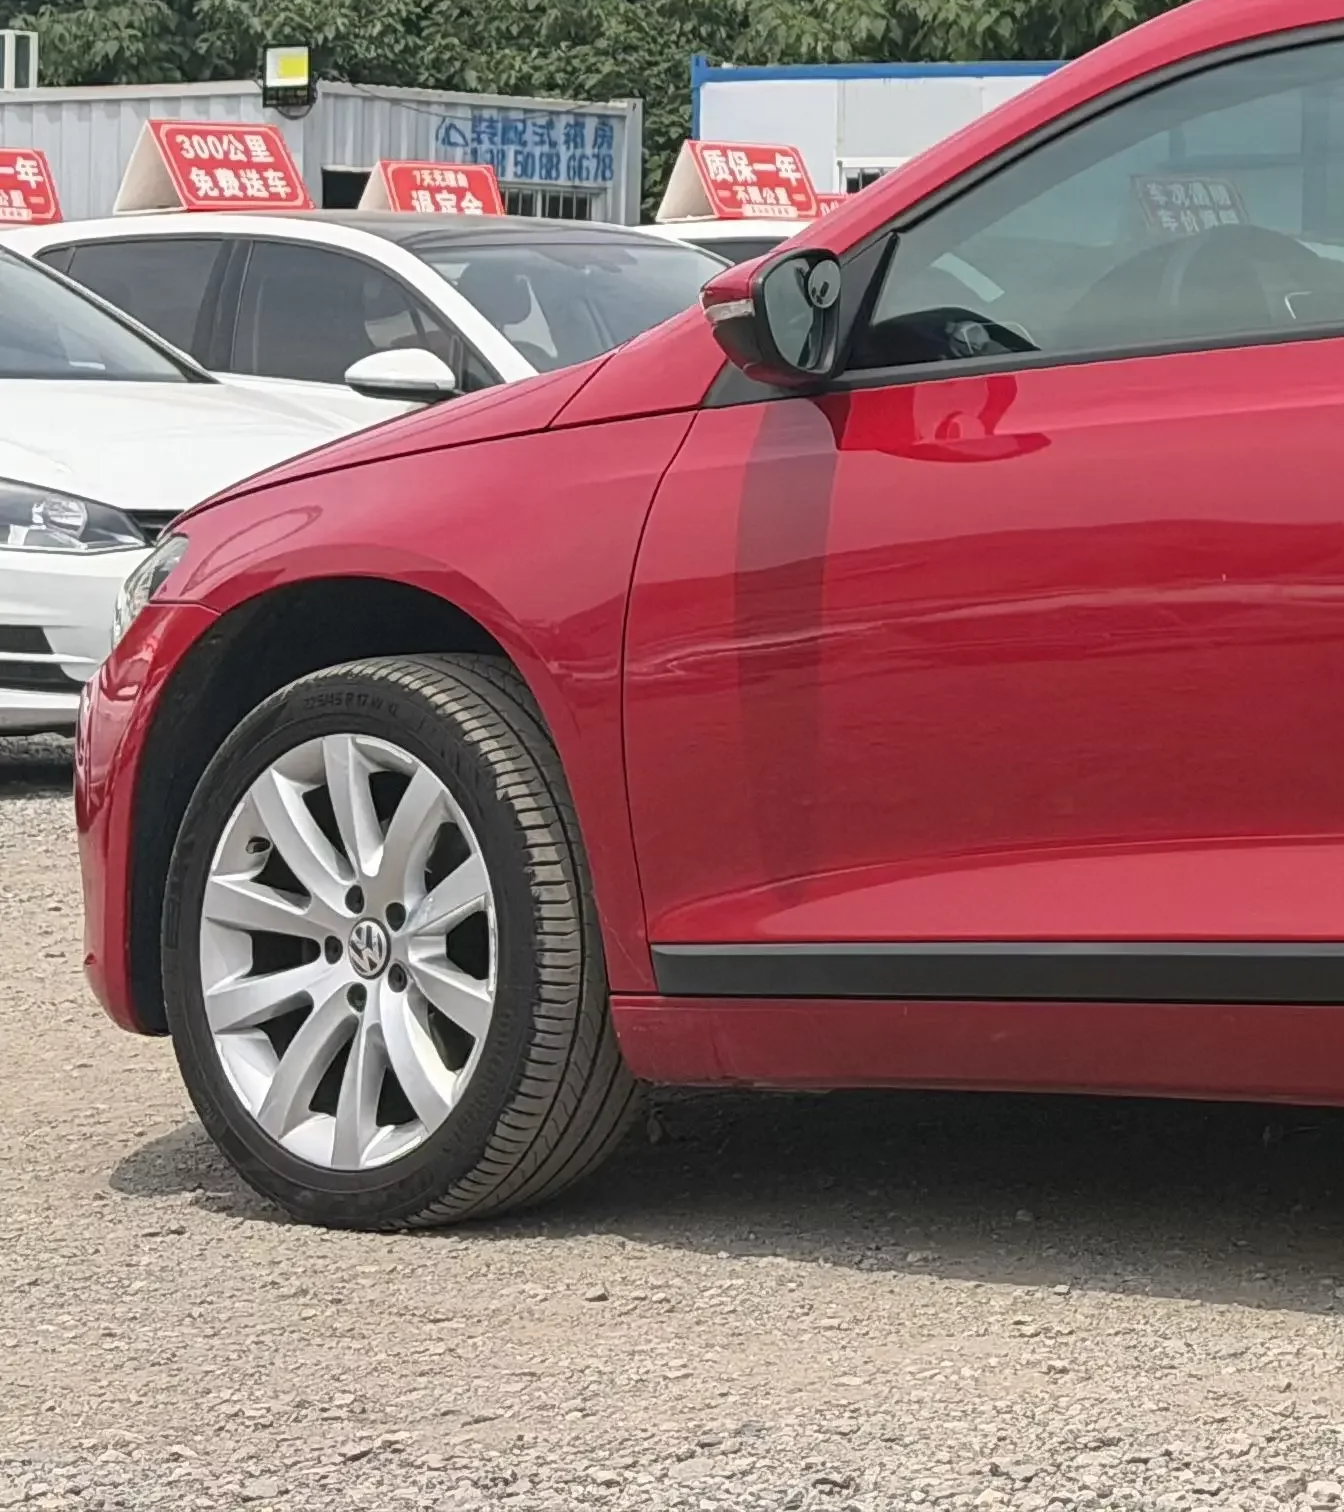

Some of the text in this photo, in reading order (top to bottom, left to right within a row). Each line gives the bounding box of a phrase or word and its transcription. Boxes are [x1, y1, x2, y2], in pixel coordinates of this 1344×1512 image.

[175, 133, 275, 163] 300公里
[188, 166, 292, 200] 免费送车
[702, 149, 802, 187] 质保一年
